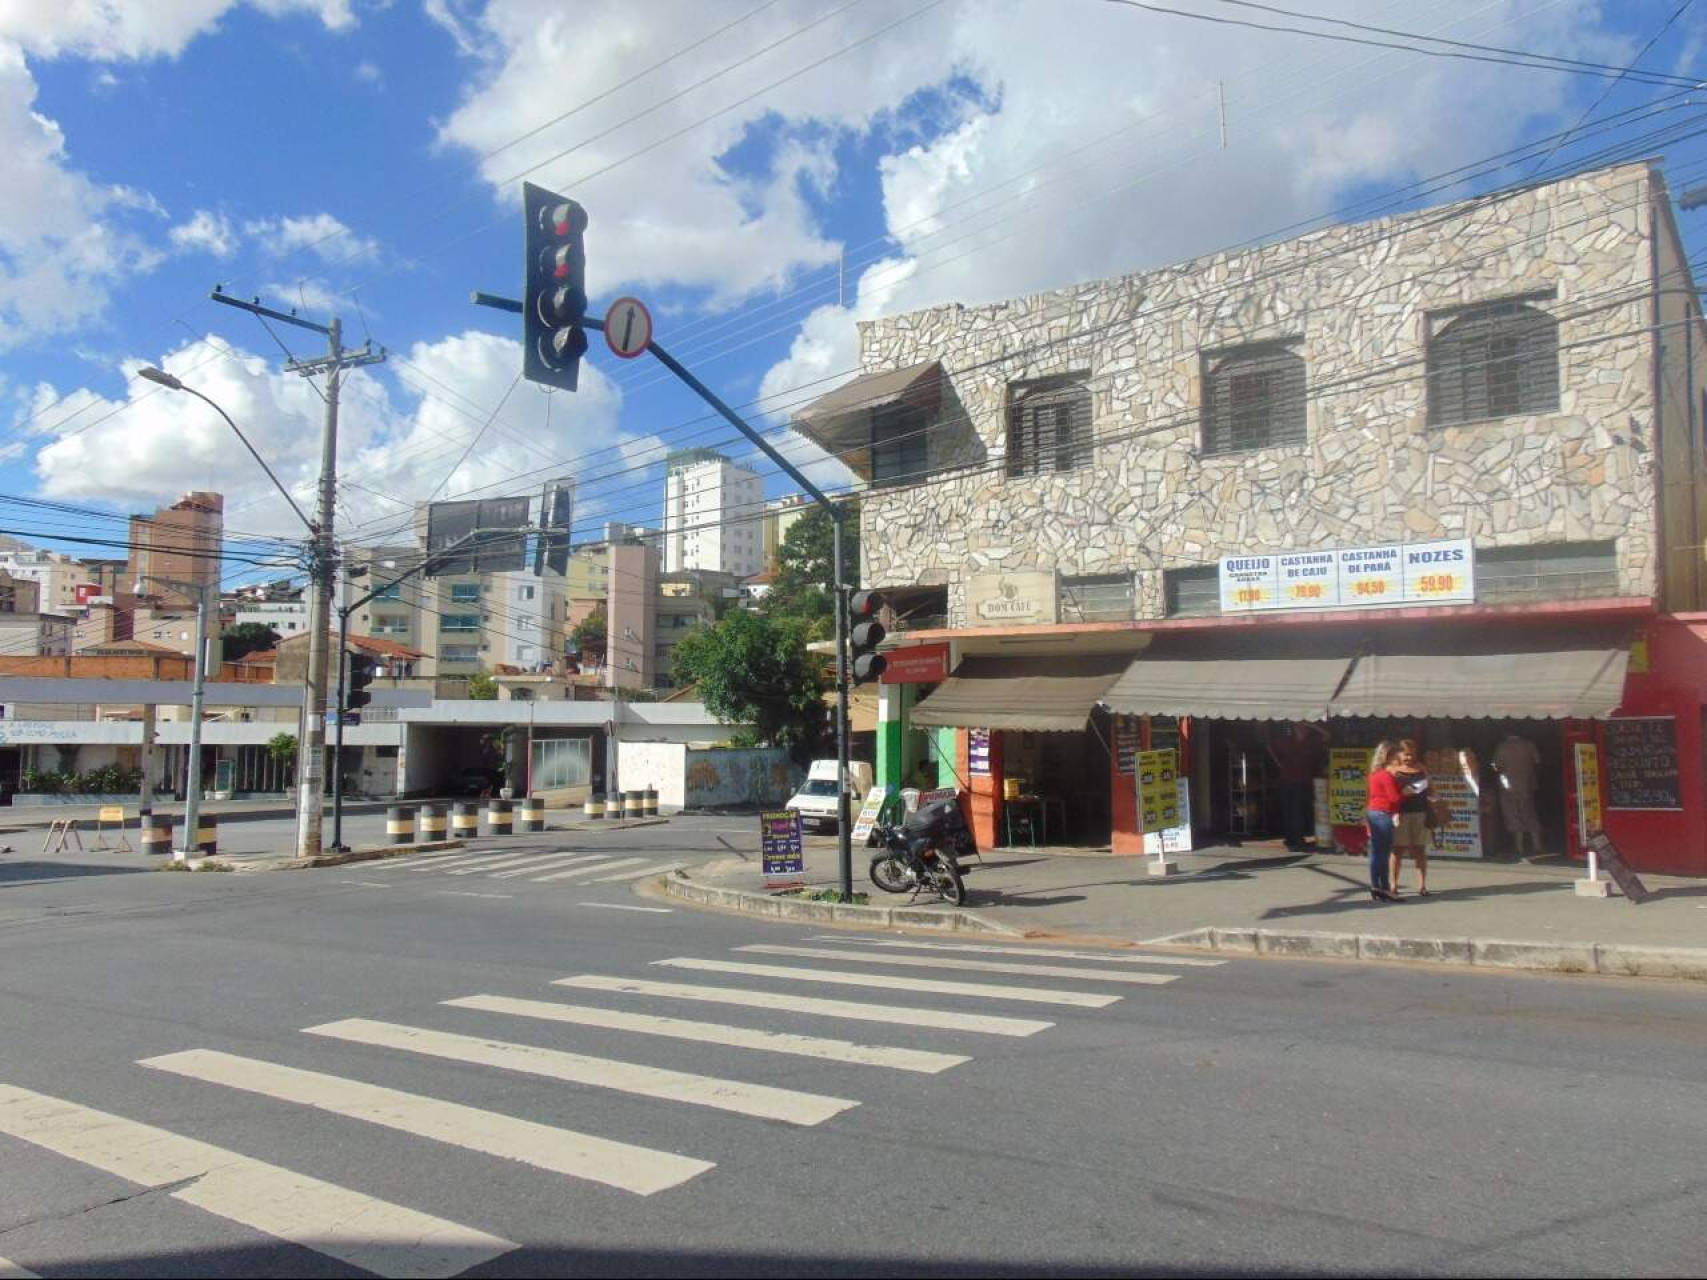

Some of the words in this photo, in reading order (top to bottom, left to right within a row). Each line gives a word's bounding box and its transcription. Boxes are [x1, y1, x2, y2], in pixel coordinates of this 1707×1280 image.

[1281, 554, 1333, 566] CASTANHA
[1342, 549, 1397, 561] CASTANHA
[1409, 549, 1463, 564] NOZES
[1226, 558, 1270, 572] QUEIJO
[1348, 564, 1360, 573] DE
[1287, 568, 1300, 577] DE
